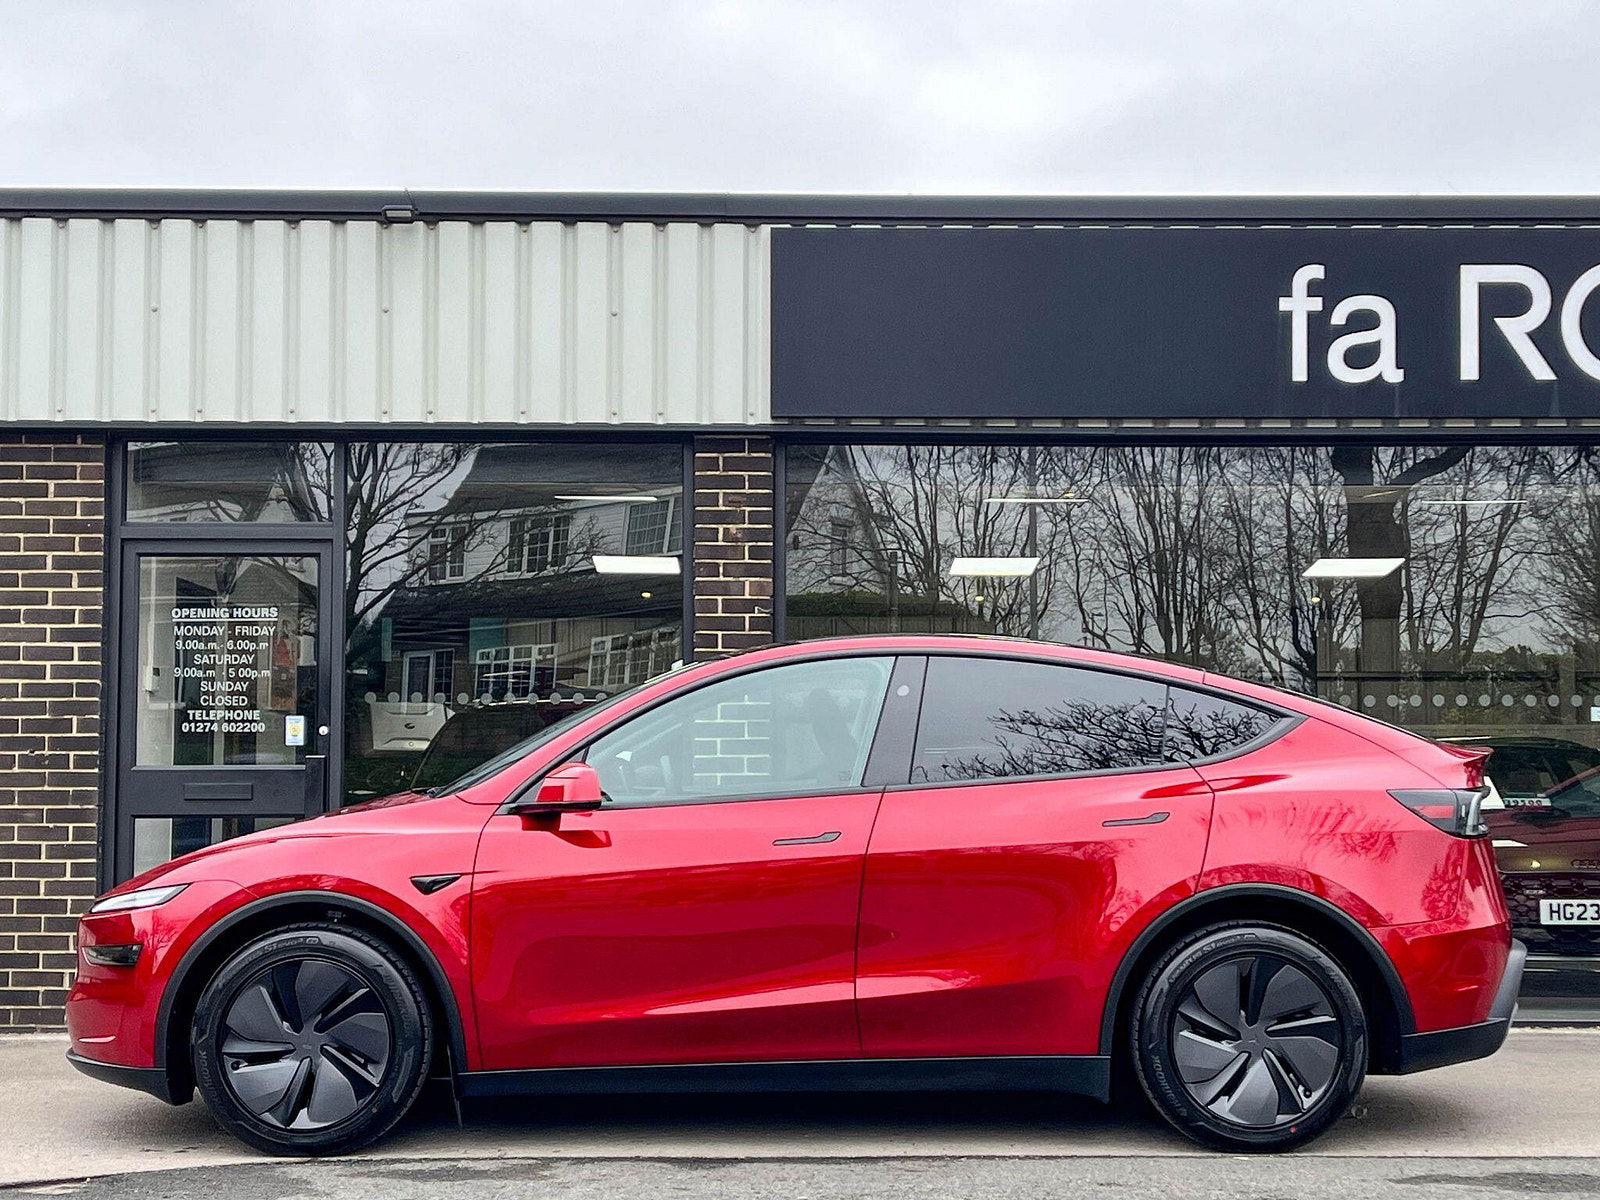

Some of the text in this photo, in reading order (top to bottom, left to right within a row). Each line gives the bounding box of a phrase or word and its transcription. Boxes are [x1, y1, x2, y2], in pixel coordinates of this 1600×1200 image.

[1278, 264, 1405, 384] fa
[171, 607, 278, 618] OPENING HOURS
[173, 626, 225, 636] MONDAY
[235, 626, 276, 636] FRIDAY
[193, 654, 255, 665] SATURDAY
[200, 681, 249, 692] SUNDAY
[200, 695, 248, 706] CLOSED
[187, 710, 261, 721] TELEPHONE
[181, 722, 266, 733] 01274 602200
[1549, 903, 1600, 921] HG23
